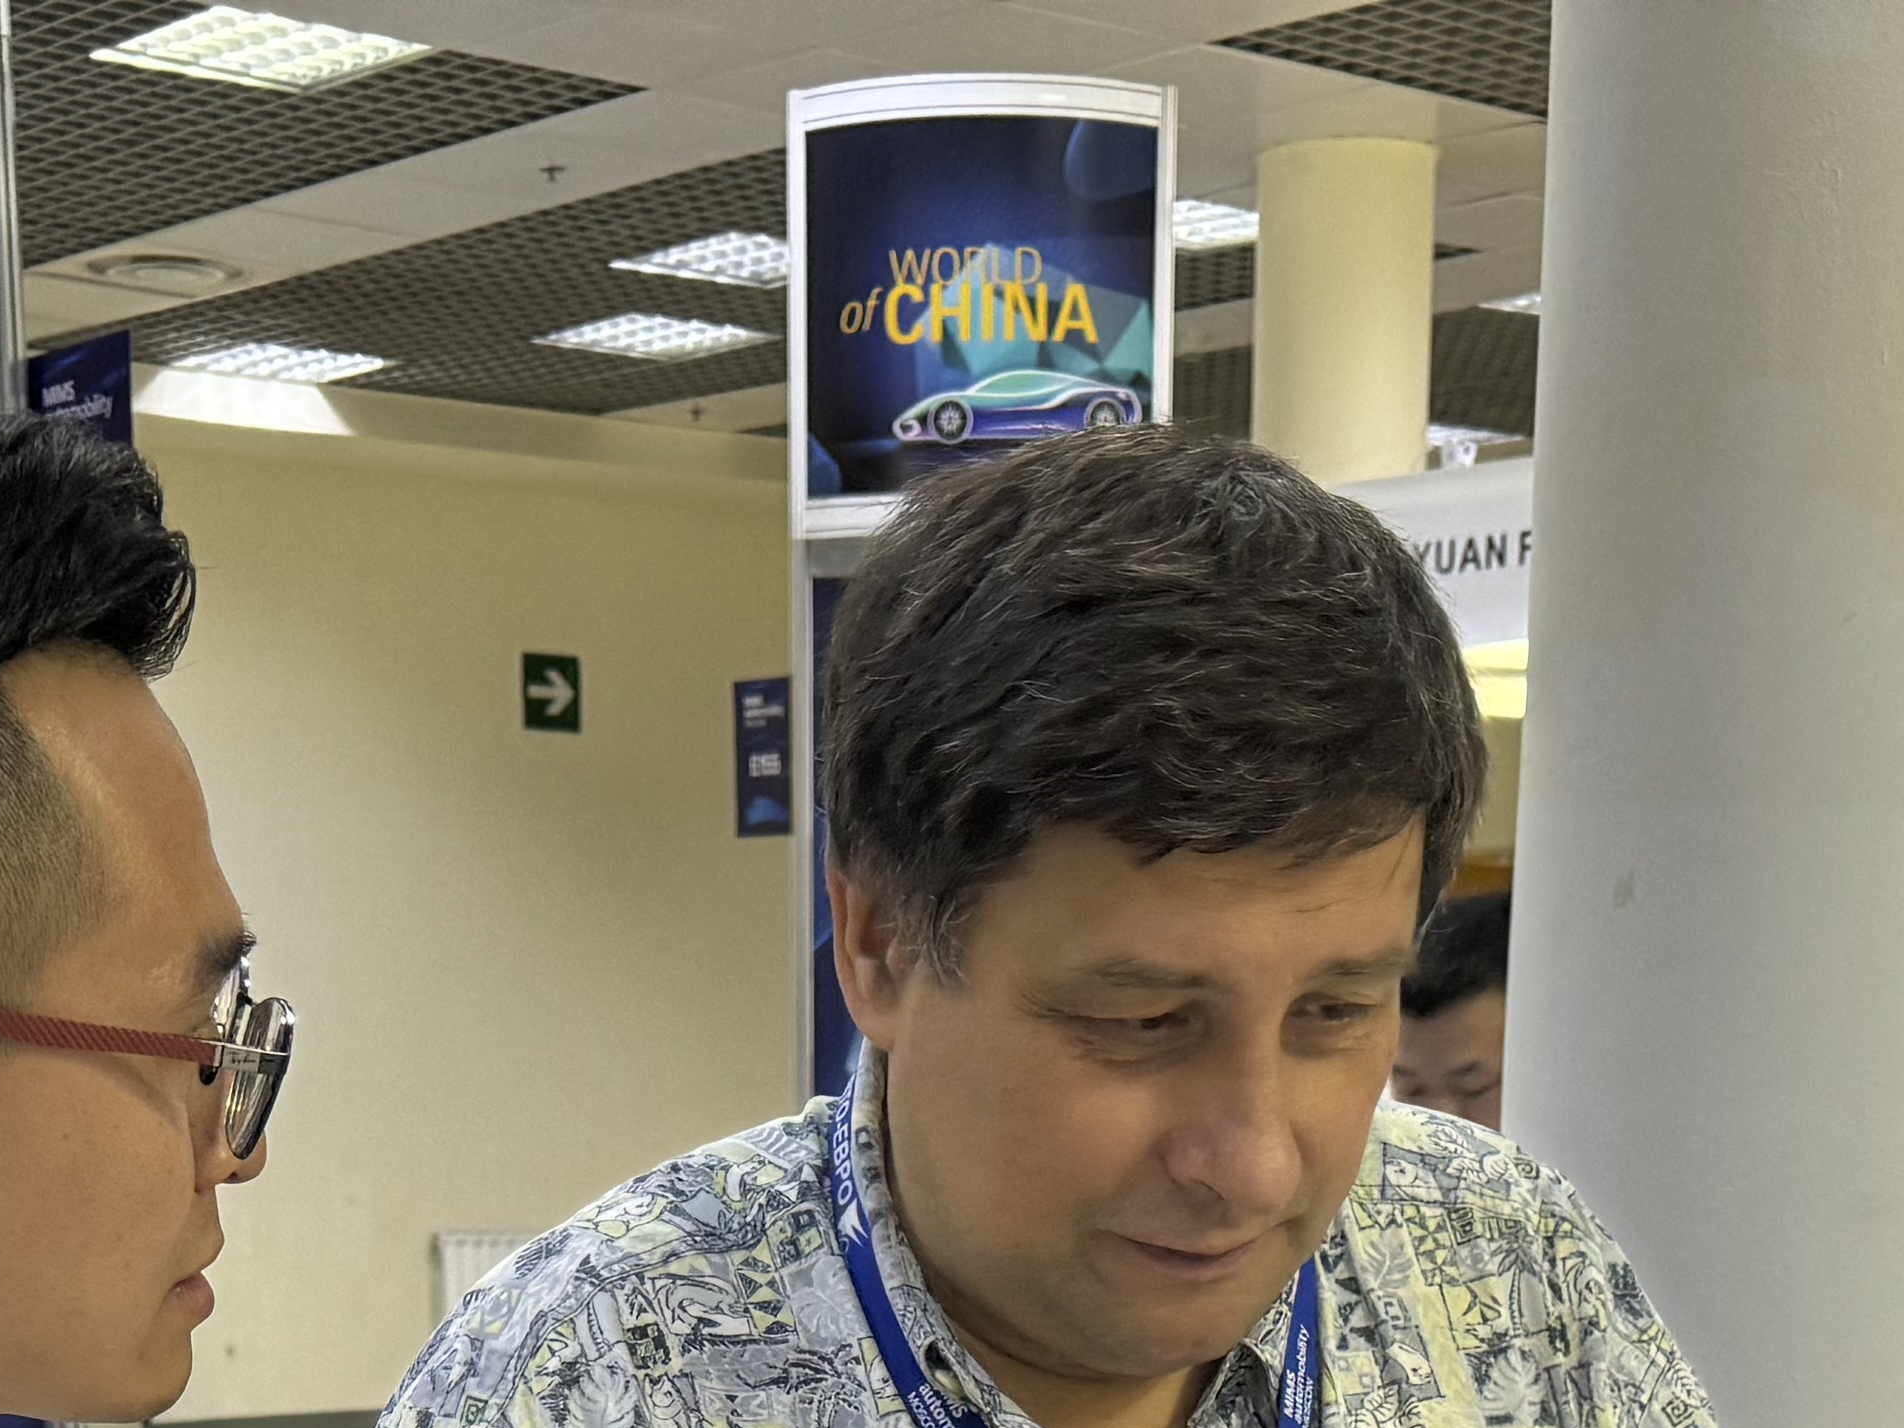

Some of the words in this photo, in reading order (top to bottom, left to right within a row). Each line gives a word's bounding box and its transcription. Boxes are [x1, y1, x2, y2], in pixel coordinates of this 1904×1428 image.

[889, 247, 1042, 286] WORLD
[839, 287, 883, 334] of
[884, 283, 1099, 345] CHINA
[1414, 534, 1508, 575] YUAN
